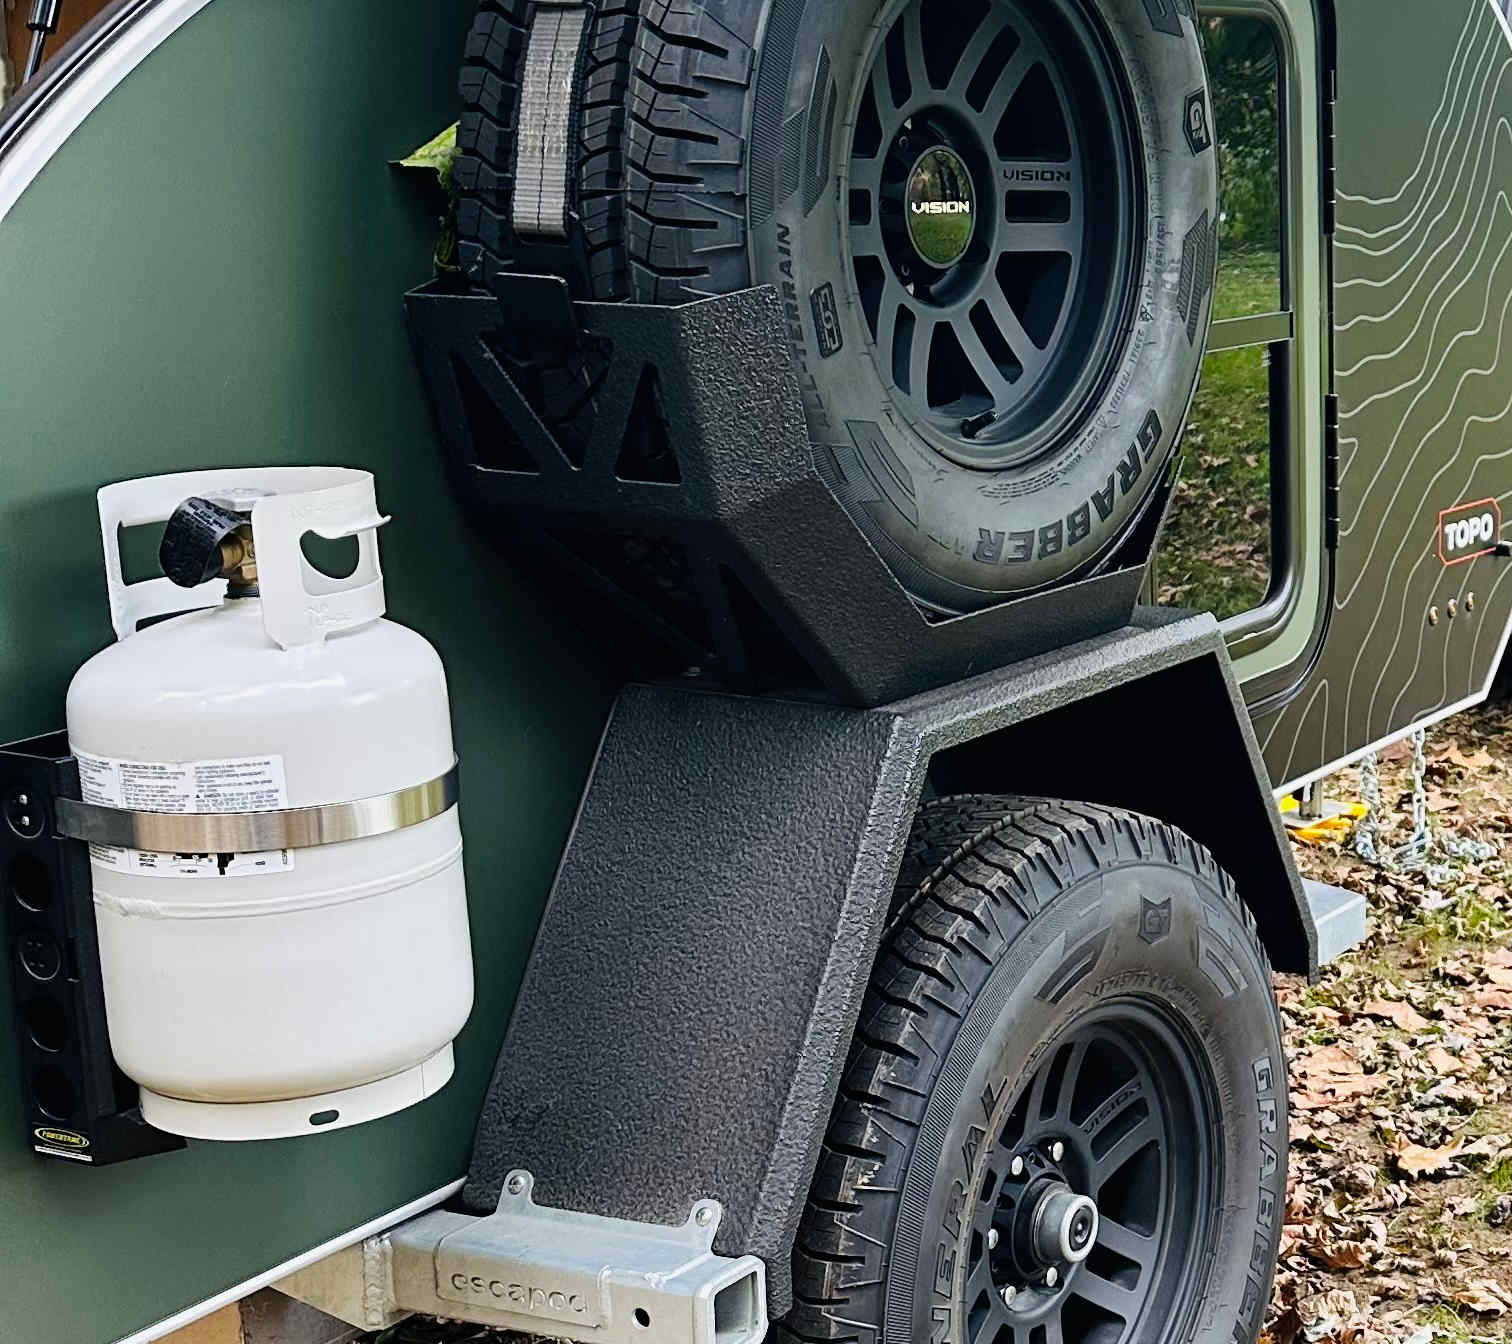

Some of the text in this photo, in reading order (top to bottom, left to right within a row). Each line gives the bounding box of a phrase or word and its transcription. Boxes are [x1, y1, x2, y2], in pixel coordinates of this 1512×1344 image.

[1002, 169, 1072, 184] VISION
[910, 199, 971, 216] VISION
[974, 408, 1163, 565] GRABBER
[1444, 512, 1494, 551] TOPO
[450, 1271, 589, 1313] escapod
